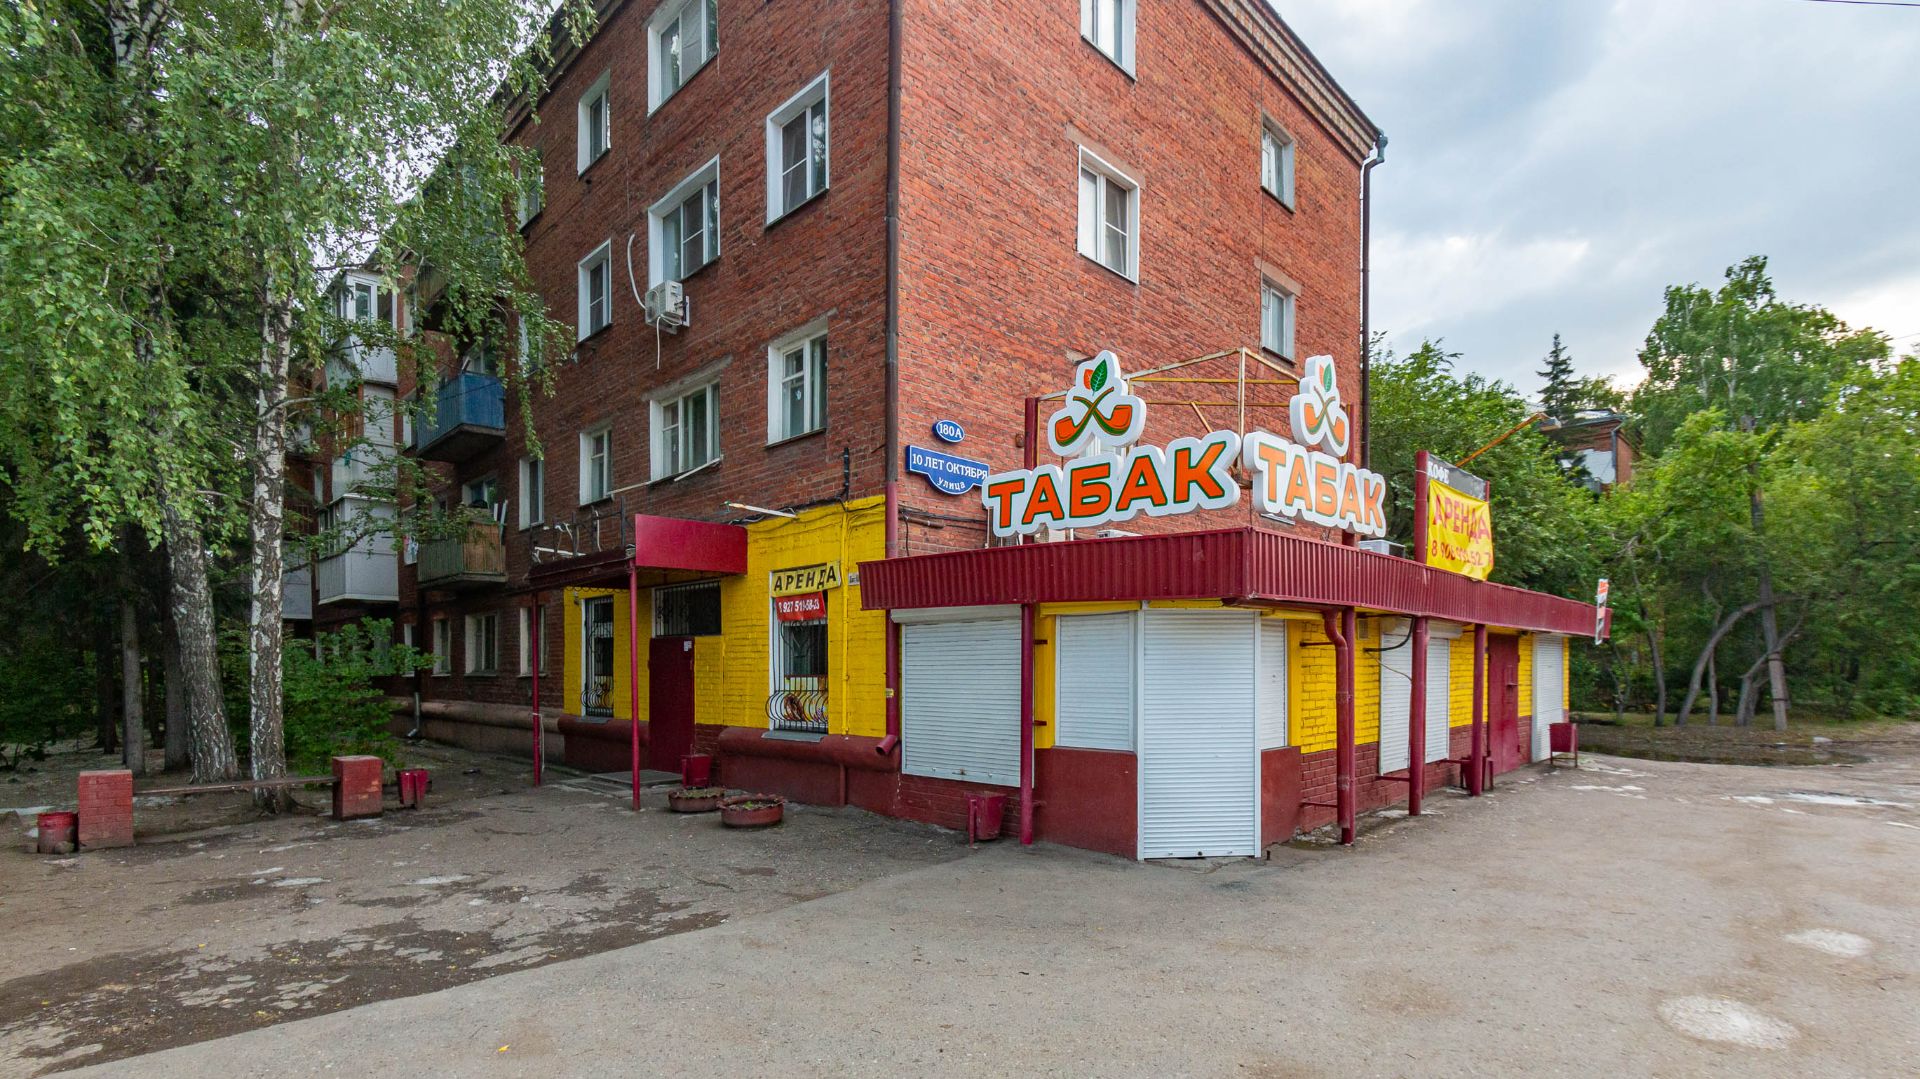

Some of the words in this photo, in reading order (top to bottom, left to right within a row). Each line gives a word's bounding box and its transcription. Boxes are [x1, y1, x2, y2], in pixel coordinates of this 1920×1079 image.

[912, 453, 923, 466] 10
[924, 456, 945, 471] ЛЕТ
[946, 461, 988, 480] ОКТЯБРЯ
[937, 476, 966, 491] улица
[988, 440, 1229, 529] ТАБАК
[1257, 440, 1383, 529] ТАБАК
[1432, 493, 1492, 545] АРЕНДА
[1431, 539, 1438, 558] 8
[773, 565, 837, 592] АРЕНДА
